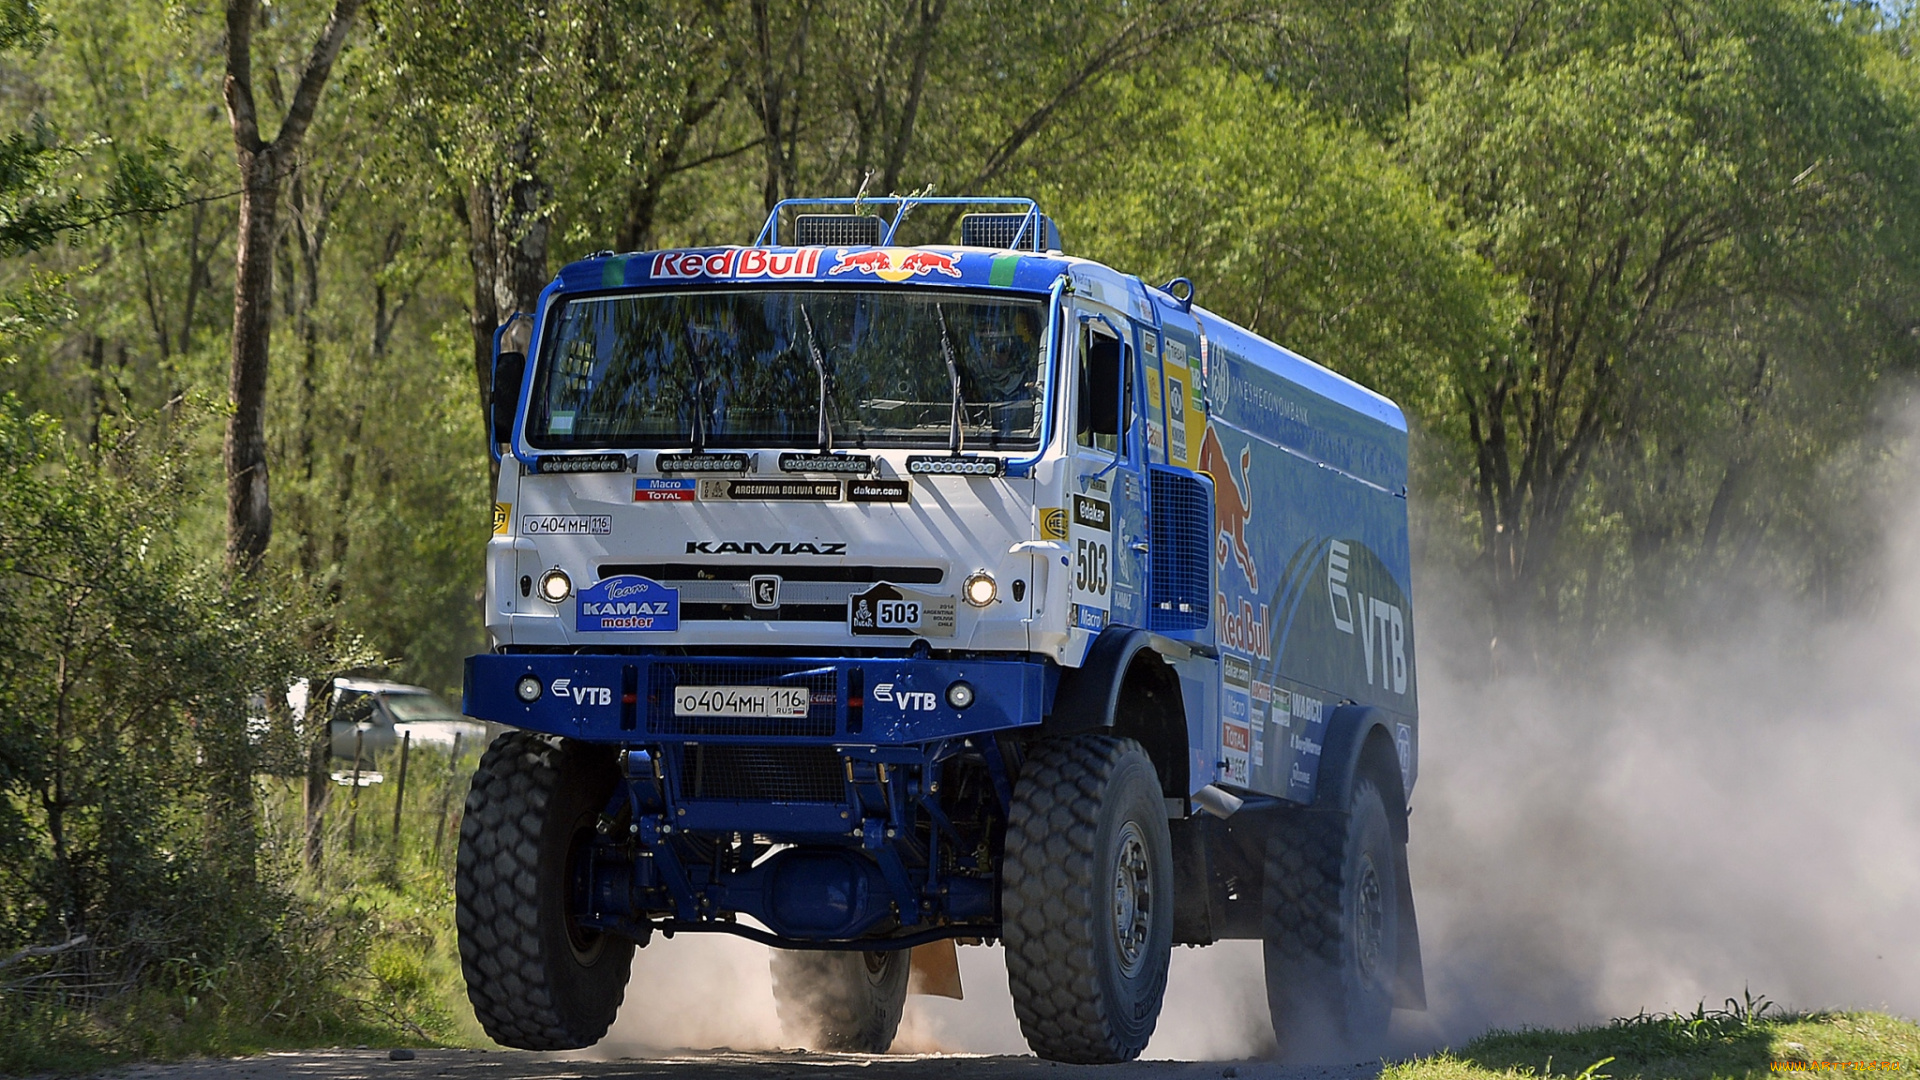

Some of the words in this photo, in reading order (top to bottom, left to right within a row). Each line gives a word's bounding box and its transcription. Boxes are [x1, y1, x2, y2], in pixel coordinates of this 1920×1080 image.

[650, 249, 737, 279] Red
[735, 248, 822, 279] Bull
[650, 479, 682, 490] Macro
[735, 485, 780, 495] ARGENTINA
[782, 485, 813, 495] BOLIVIA
[815, 485, 838, 496] CHILE
[853, 483, 903, 496] dakar.com
[647, 491, 682, 500] TOTAL
[1079, 500, 1105, 524] @dakar
[591, 517, 607, 528] 116
[685, 541, 847, 556] KAMAZ
[1076, 538, 1108, 597] 503
[604, 579, 649, 601] Team
[583, 602, 669, 616] KAMAZ
[881, 603, 919, 624] 503
[1080, 608, 1101, 628] Macro
[601, 616, 654, 629] master
[1218, 590, 1246, 653] Red
[1243, 599, 1271, 661] Bull
[1357, 592, 1407, 695] VTB
[1225, 659, 1249, 681] dakar.com
[572, 687, 612, 706] VTB
[770, 690, 801, 707] 116
[895, 690, 937, 711] VTB
[1292, 692, 1323, 724] WABCO
[1225, 726, 1246, 750] TOTAL
